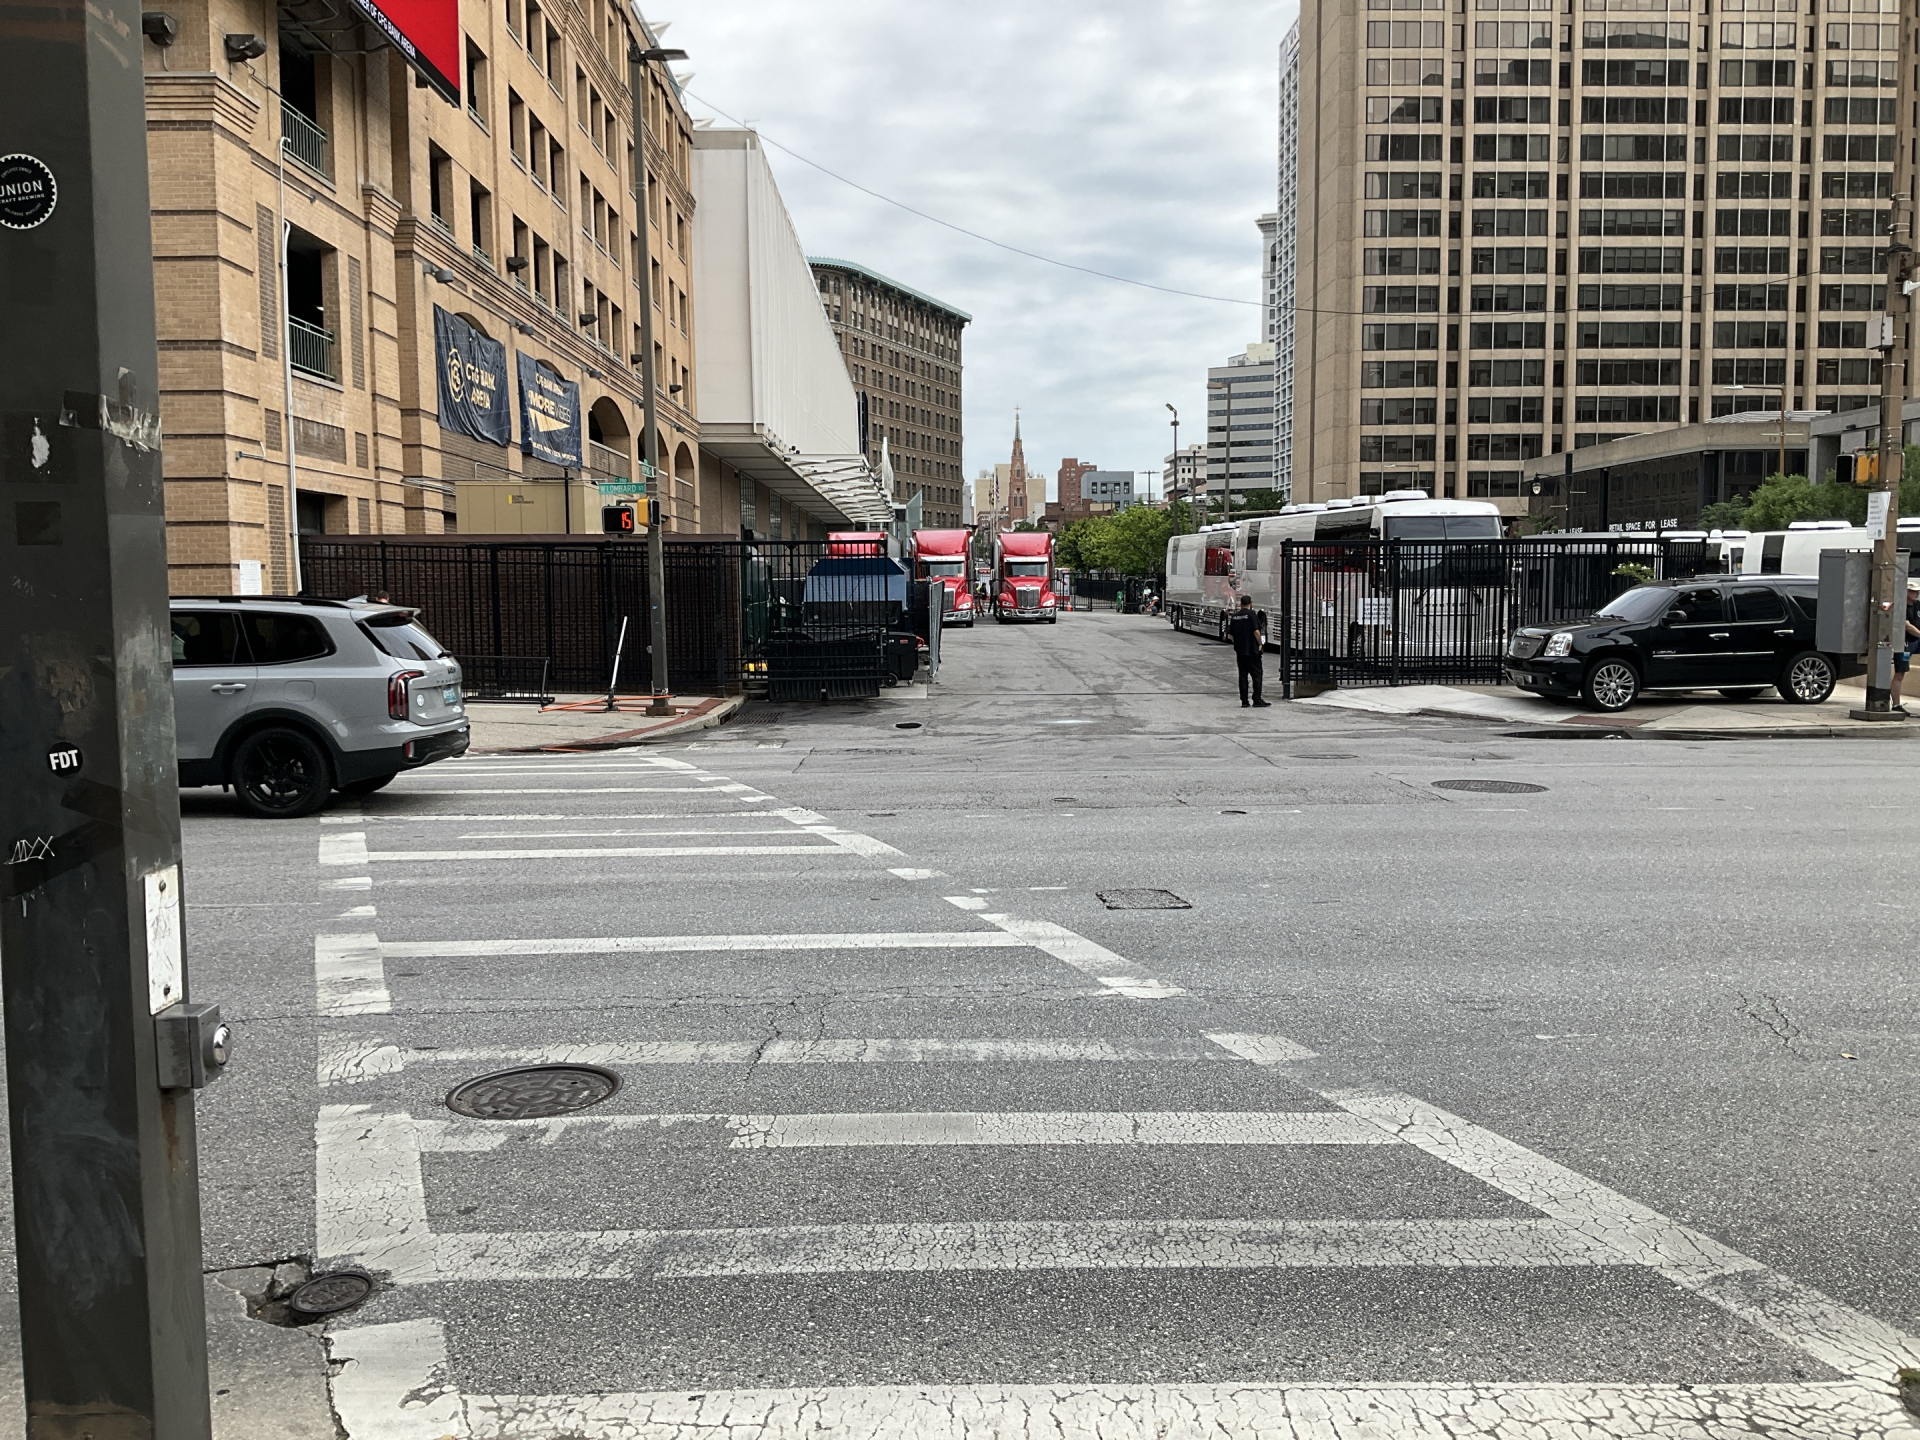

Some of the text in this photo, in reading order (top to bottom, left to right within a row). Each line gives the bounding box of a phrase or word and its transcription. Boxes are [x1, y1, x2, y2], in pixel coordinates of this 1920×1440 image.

[370, 4, 377, 18] OF
[378, 11, 387, 30] CFG
[388, 20, 401, 44] BANK
[401, 35, 416, 59] ARENA
[466, 363, 496, 390] CFG BANK
[471, 387, 490, 410] ARENA
[622, 512, 631, 529] 15
[1609, 518, 1678, 532] RETAIL SPACE FOR LEASE
[49, 750, 78, 770] FDT
